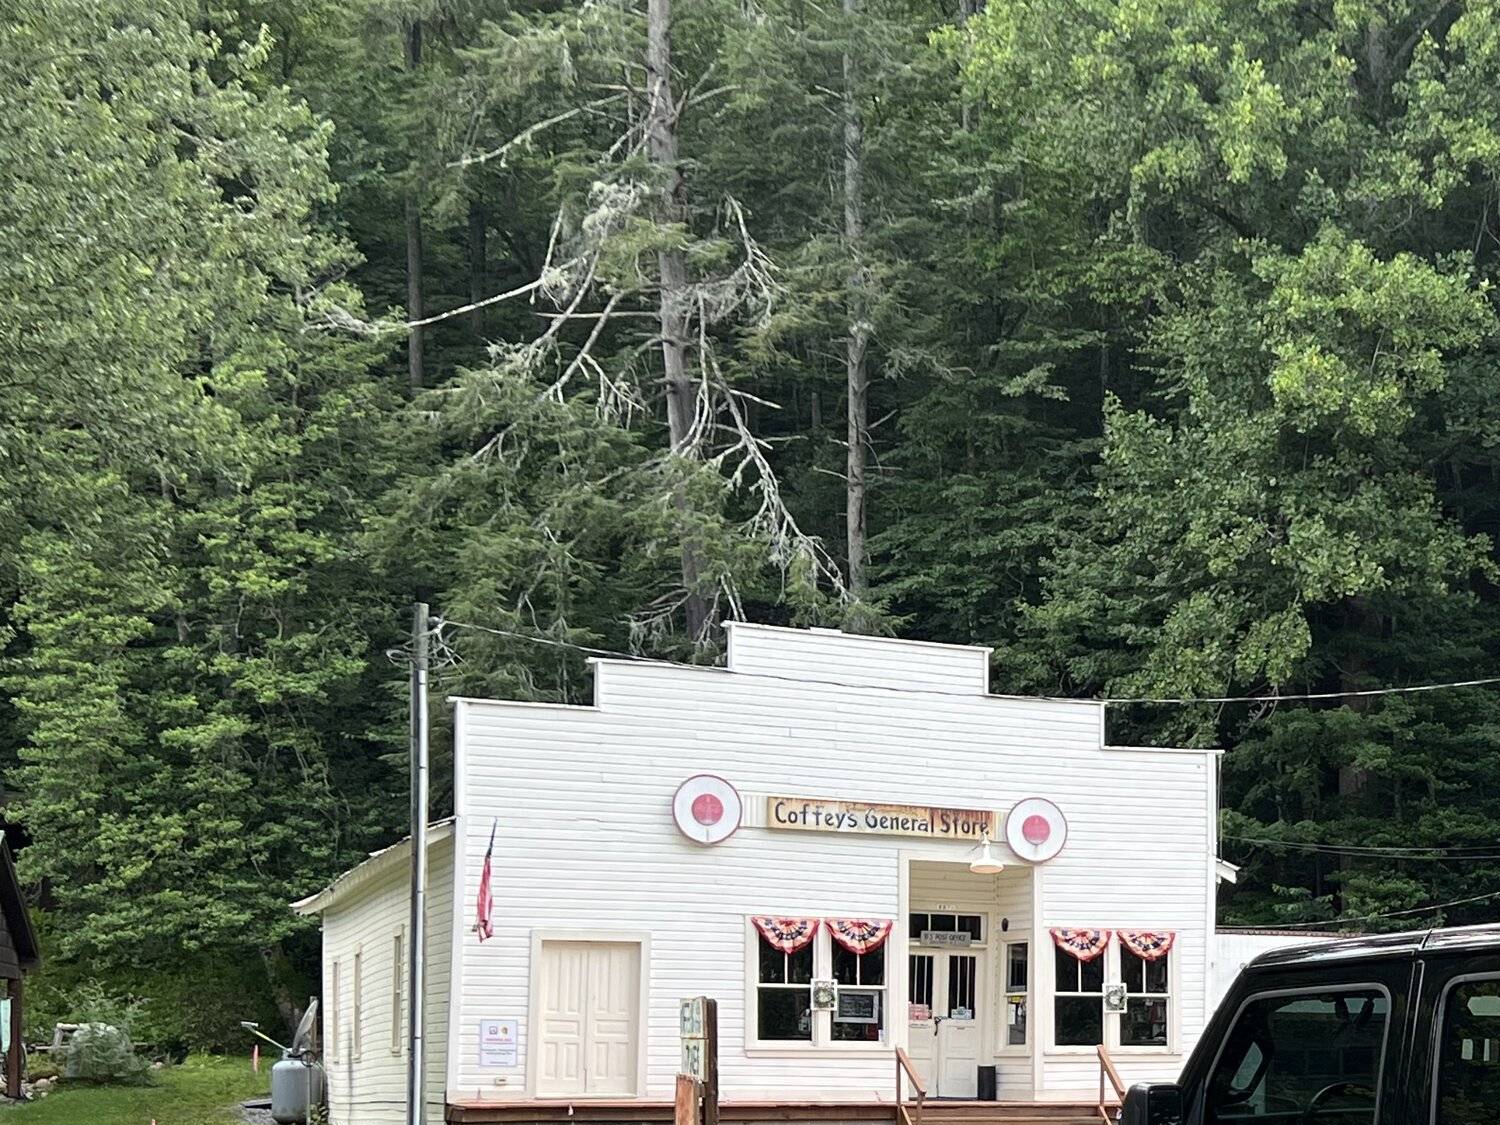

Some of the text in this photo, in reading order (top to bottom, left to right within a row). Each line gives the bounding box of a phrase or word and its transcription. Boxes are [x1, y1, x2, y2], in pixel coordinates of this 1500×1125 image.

[775, 801, 989, 835] Coffey's General Store
